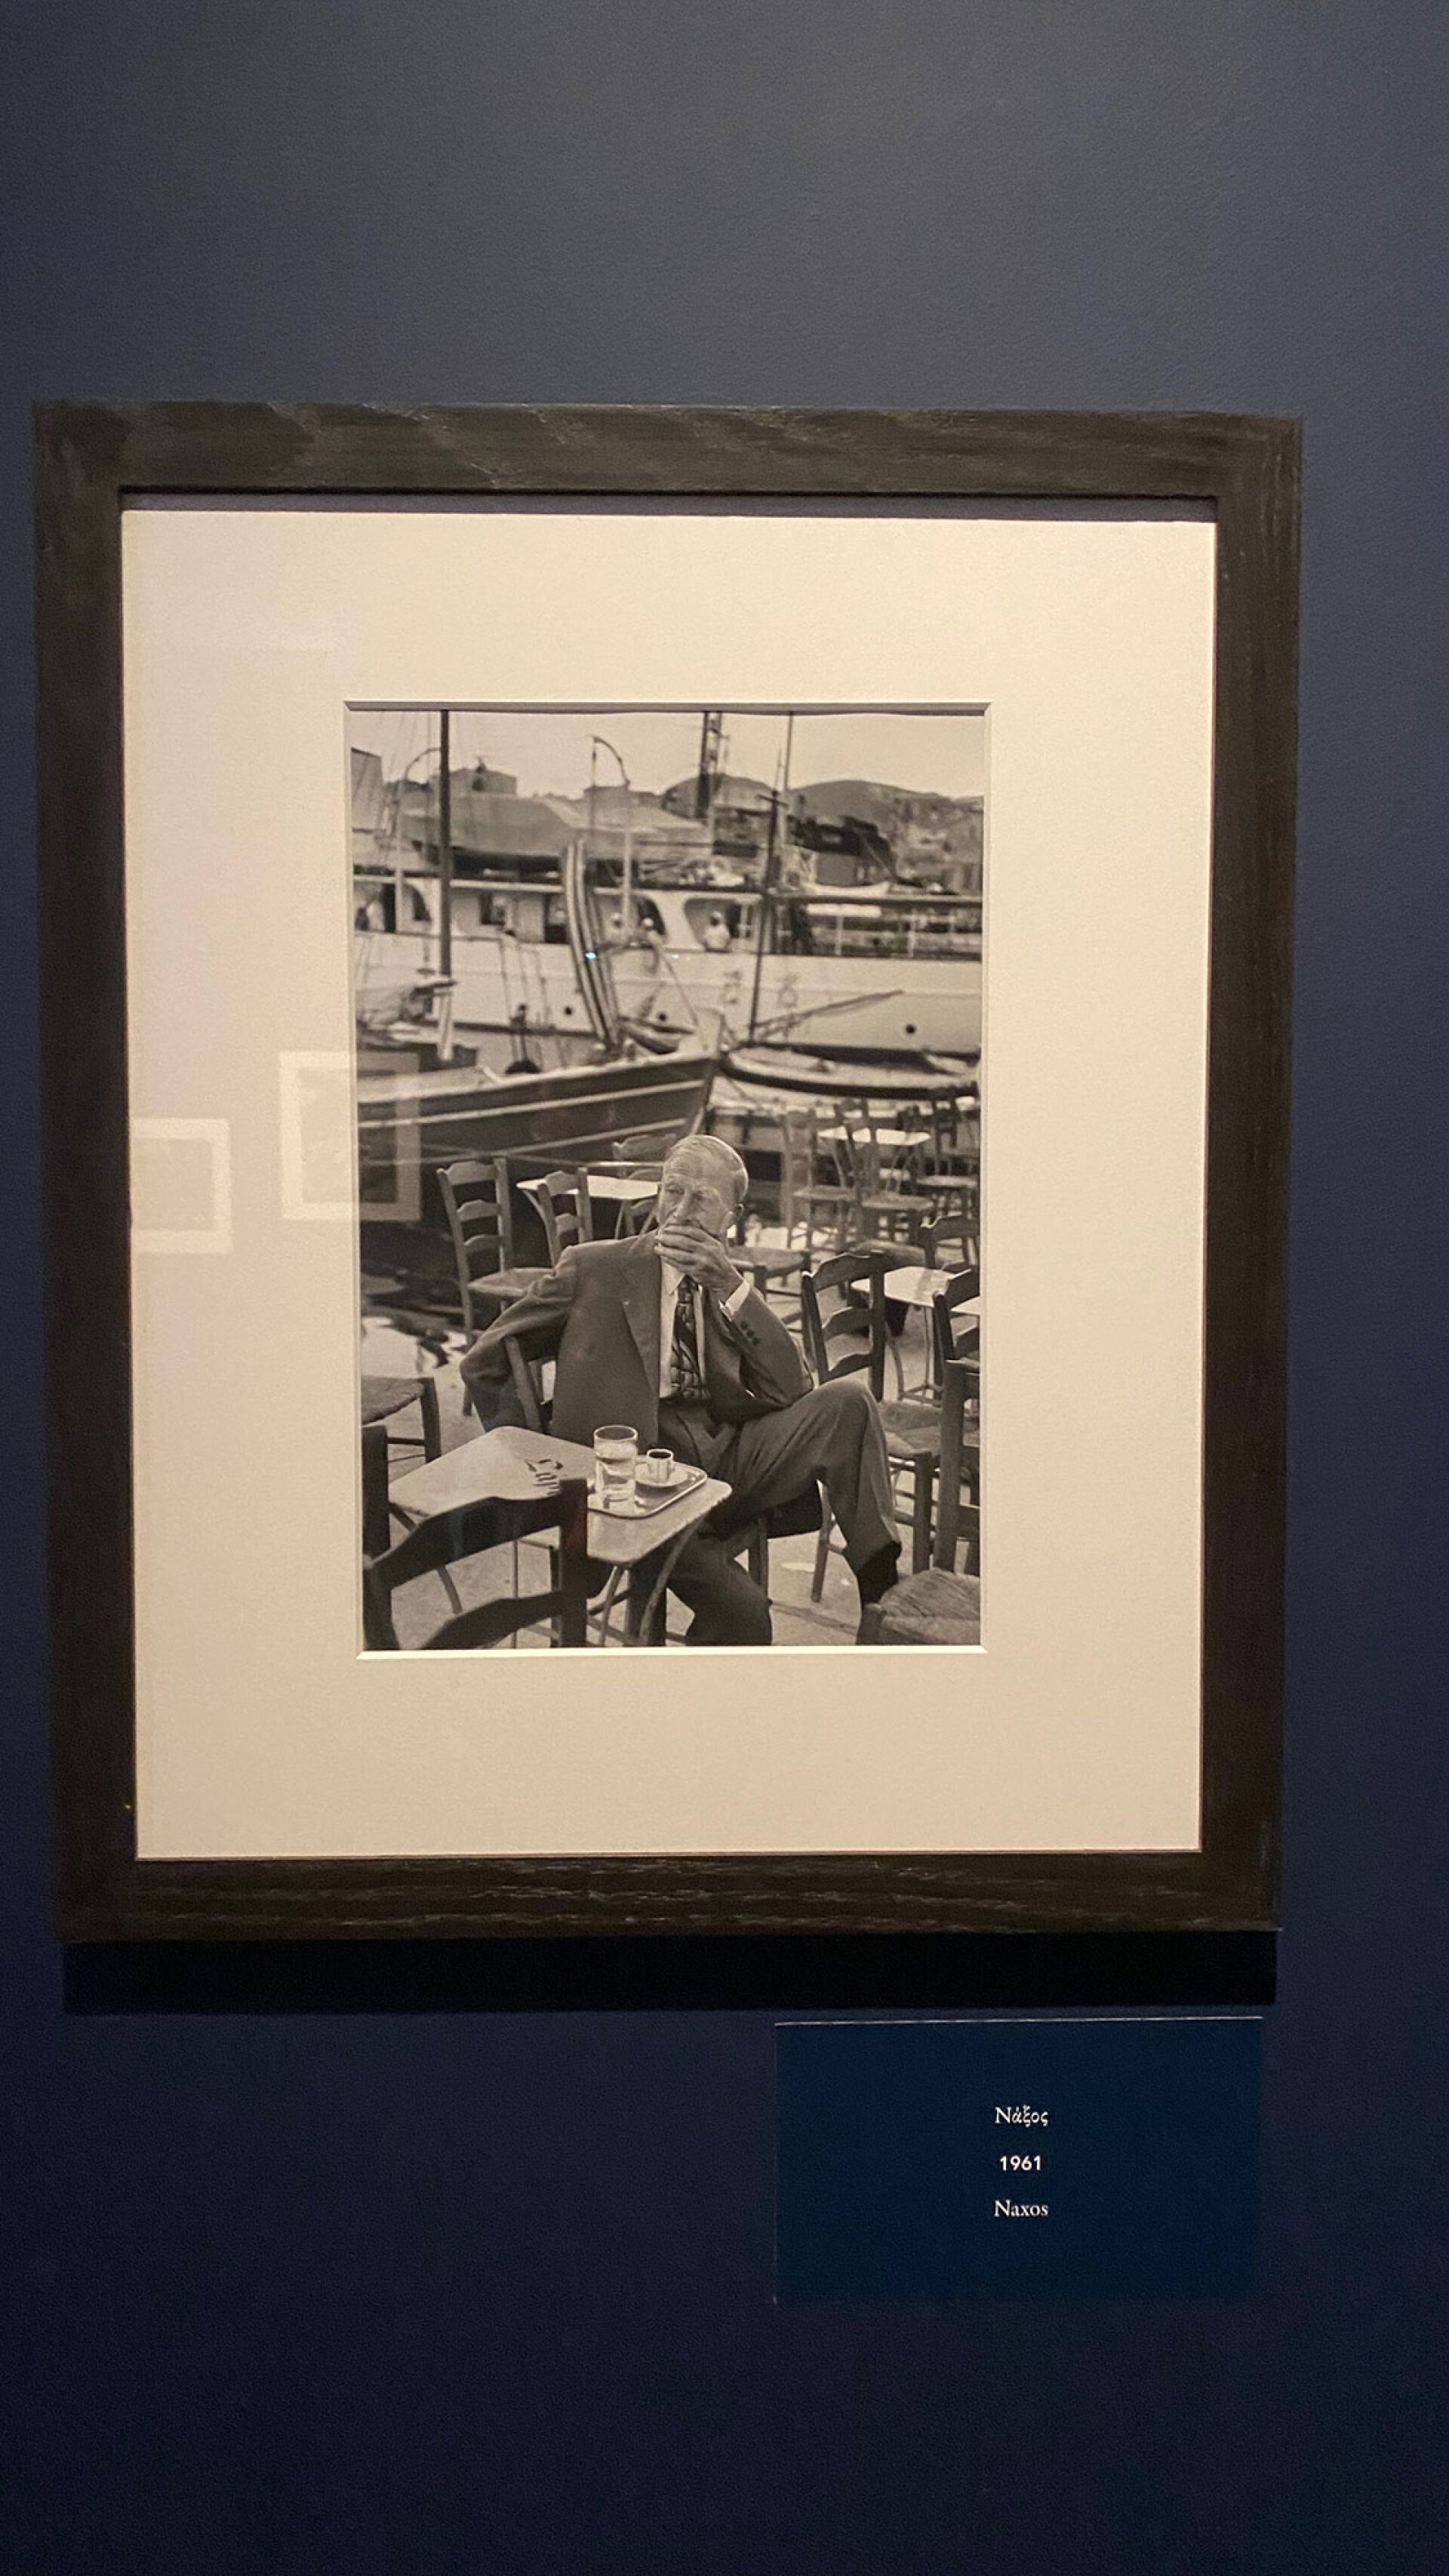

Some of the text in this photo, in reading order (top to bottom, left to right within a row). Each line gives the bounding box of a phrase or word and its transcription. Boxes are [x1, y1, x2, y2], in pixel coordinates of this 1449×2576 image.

[994, 2104, 1049, 2128] Νάξος
[1000, 2155, 1041, 2171] 1961
[994, 2199, 1049, 2217] Naxos
